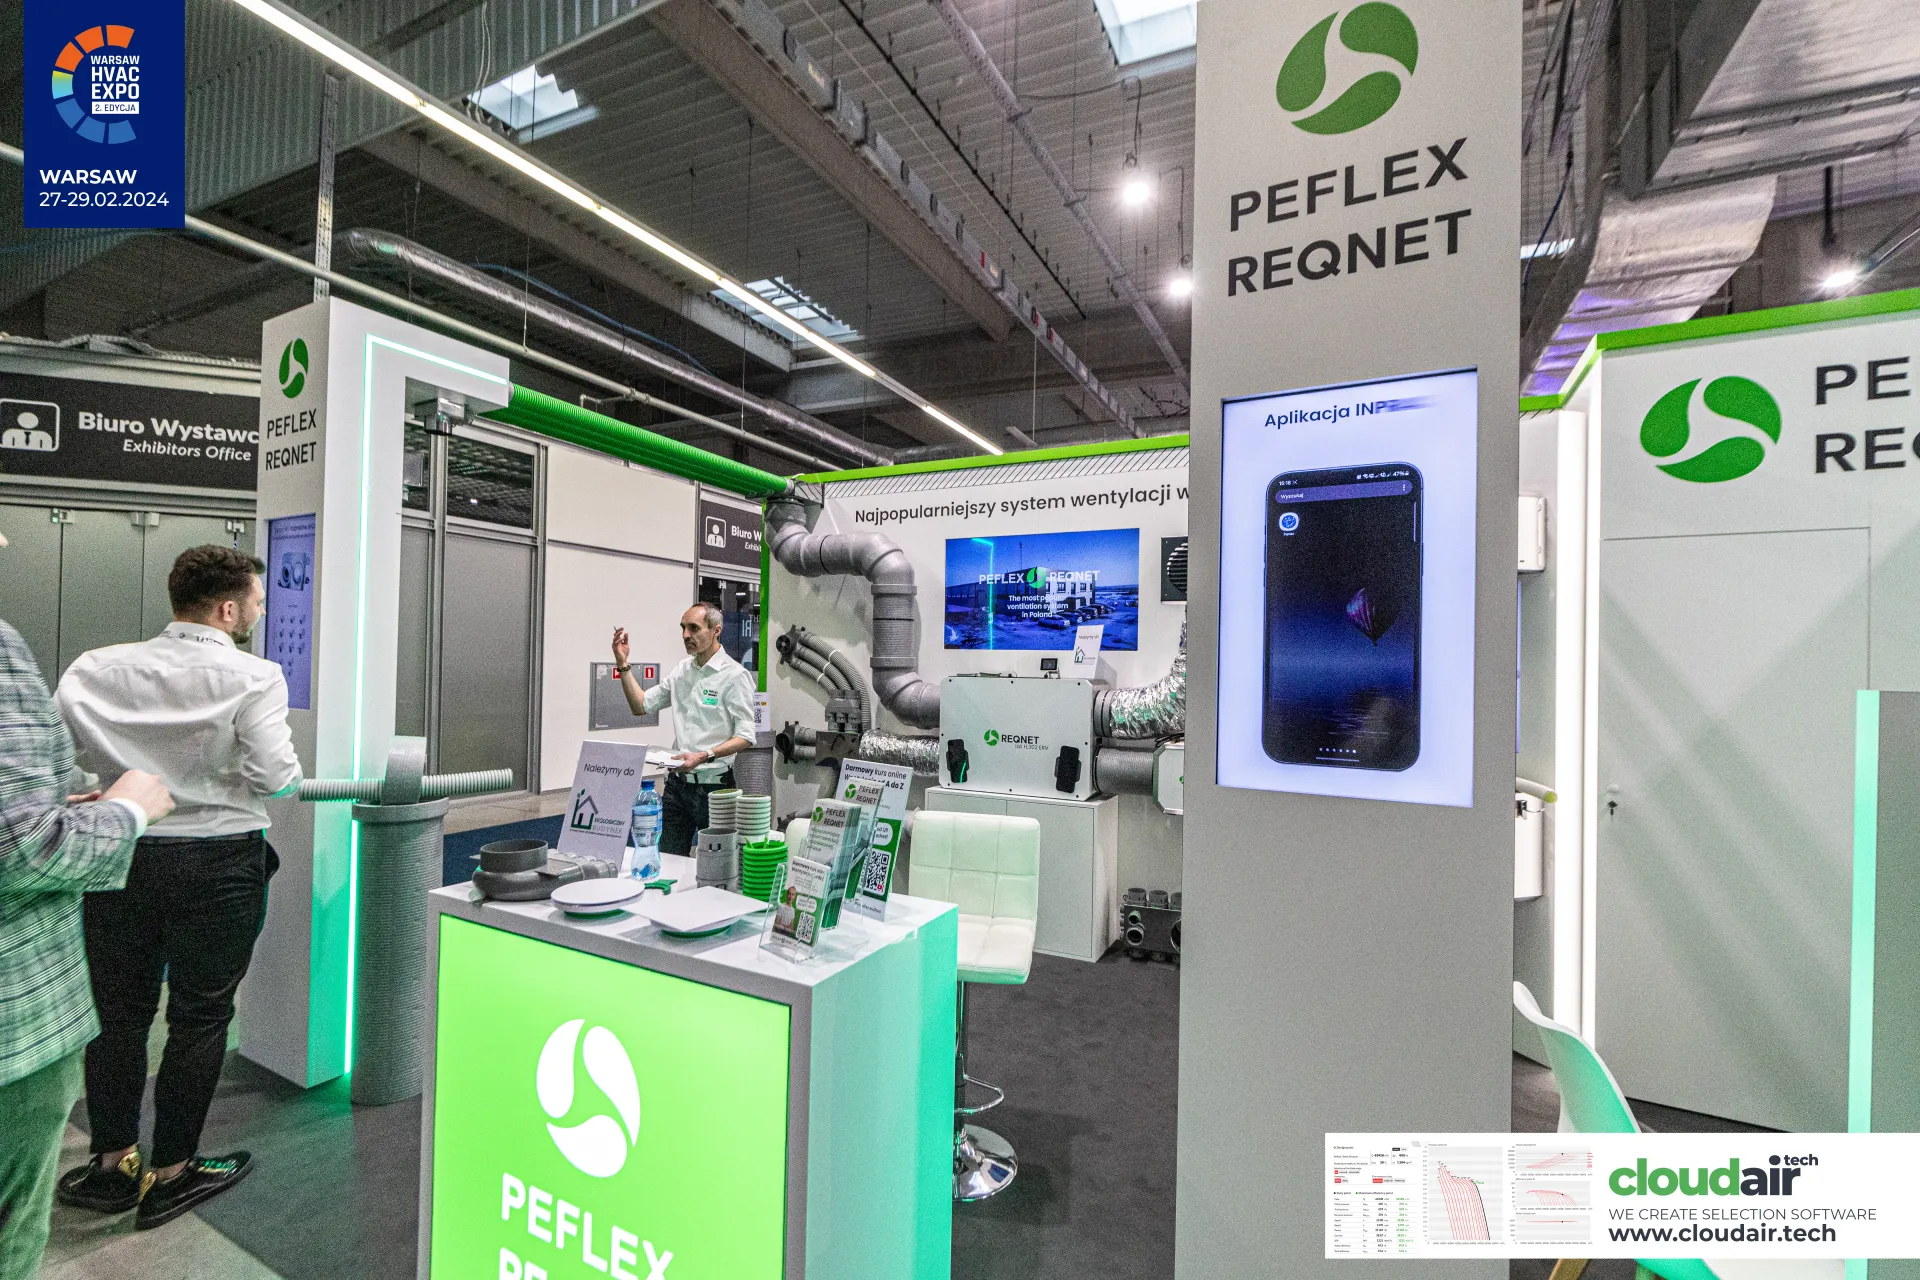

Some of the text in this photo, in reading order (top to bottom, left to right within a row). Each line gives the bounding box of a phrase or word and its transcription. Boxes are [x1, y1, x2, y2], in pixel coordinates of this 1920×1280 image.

[1230, 137, 1469, 232] PEFLEX
[1228, 208, 1472, 297] REQNET
[1815, 356, 1912, 406] PE
[266, 409, 317, 439] PEFLEX
[1264, 404, 1350, 430] Aplikacja
[78, 411, 259, 445] Biuro Wystawc
[122, 439, 252, 461] Exhibitors Office
[265, 442, 317, 471] REQNET
[1815, 427, 1920, 474] RE
[855, 499, 997, 526] Najpopularniejszy
[1000, 495, 1066, 517] system
[1070, 484, 1171, 508] wentylacji
[731, 524, 752, 540] Biuro
[978, 570, 1100, 585] PEFLEX REQNET
[1007, 602, 1043, 610] ventilation
[1001, 734, 1040, 745] REQNET
[583, 763, 635, 778] Należymy do
[845, 763, 874, 777] Darmowy
[874, 768, 887, 777] kurs
[887, 770, 907, 780] online
[858, 784, 880, 795] PEFLEX
[885, 780, 905, 790] A do Z
[855, 794, 877, 805] REQNET
[825, 807, 847, 818] PEFLEX
[823, 817, 845, 828] REQNET
[501, 1172, 674, 1280] PEFLEX
